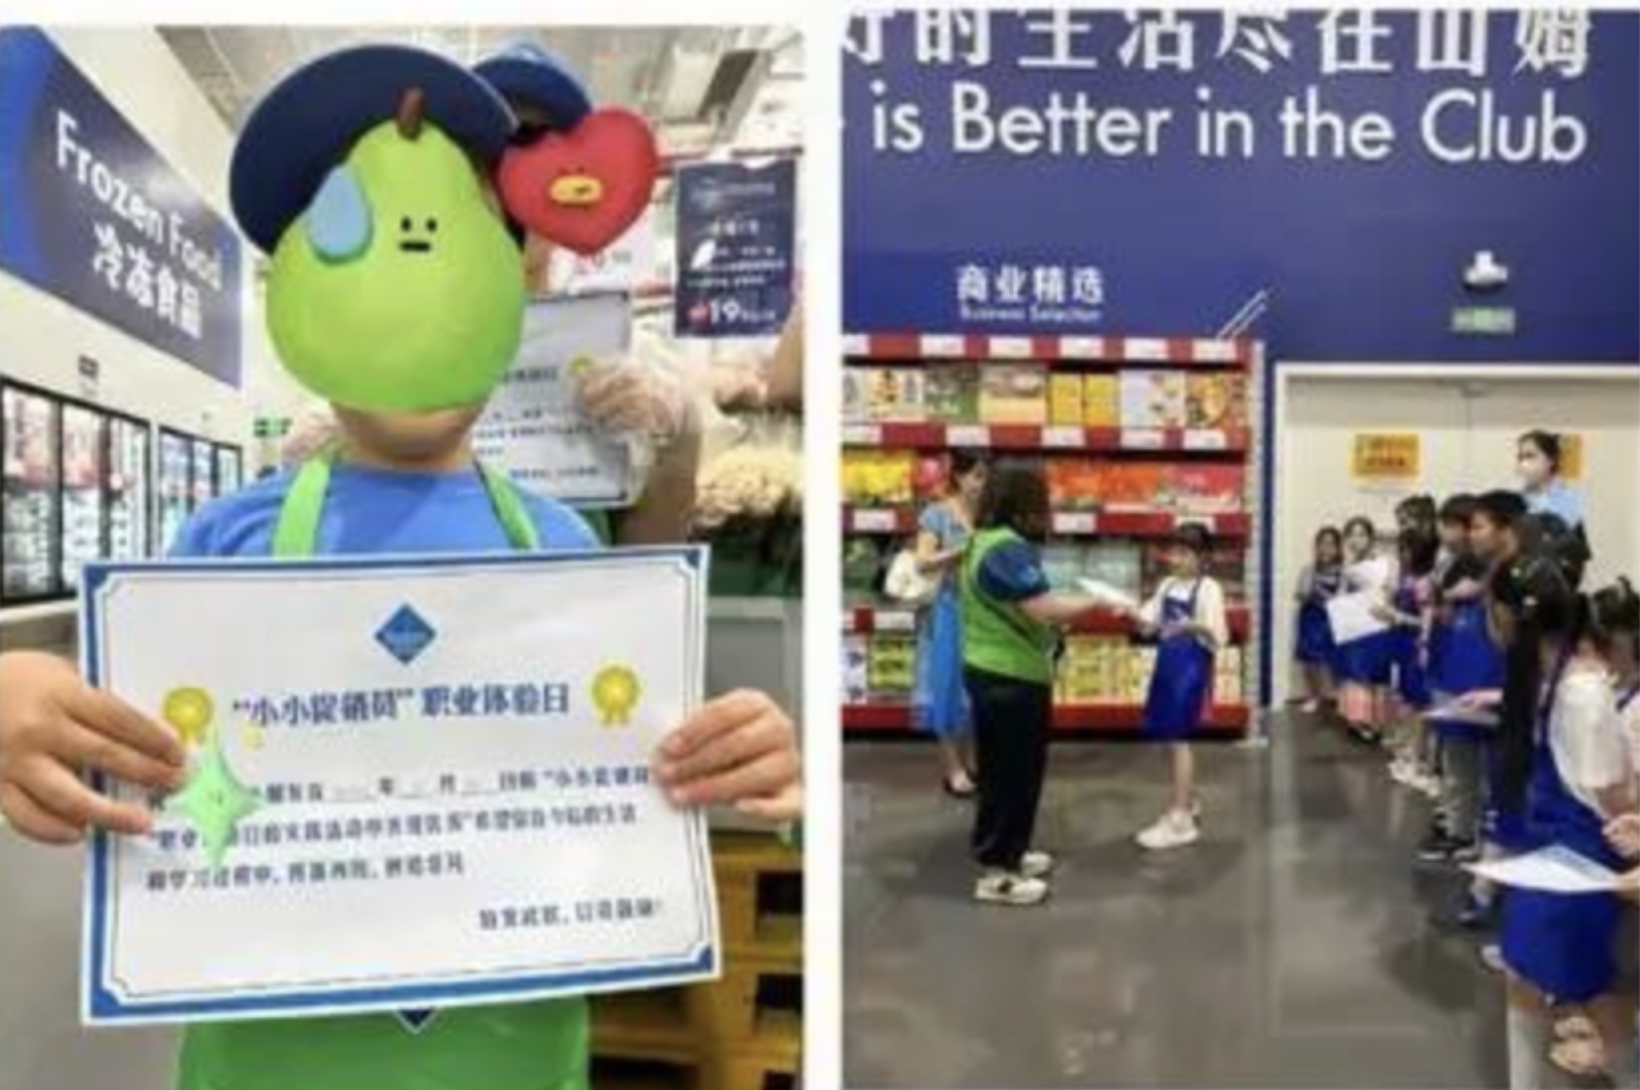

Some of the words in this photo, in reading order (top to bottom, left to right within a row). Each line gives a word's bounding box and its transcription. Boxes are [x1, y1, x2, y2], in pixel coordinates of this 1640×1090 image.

[869, 79, 924, 152] is
[952, 81, 1172, 155] Better
[1196, 86, 1254, 157] in
[1278, 85, 1395, 158] the
[1420, 87, 1588, 163] Club
[57, 108, 164, 246] Frozen
[93, 221, 202, 341] 冷冻食品
[421, 683, 569, 717] 职业体验日
